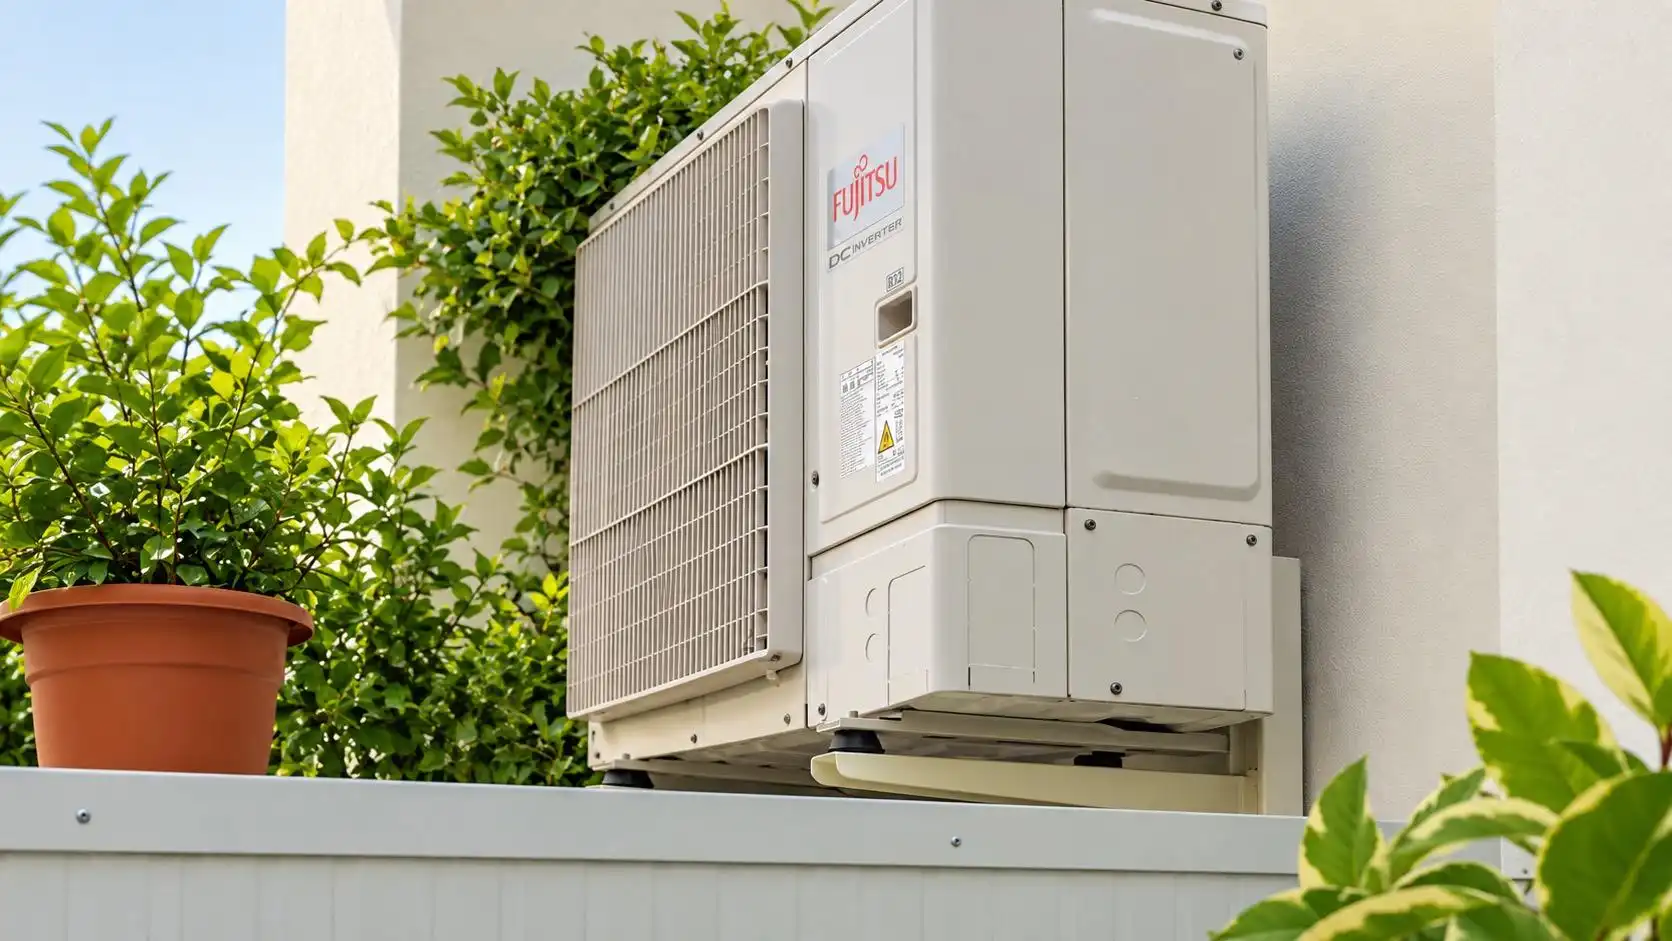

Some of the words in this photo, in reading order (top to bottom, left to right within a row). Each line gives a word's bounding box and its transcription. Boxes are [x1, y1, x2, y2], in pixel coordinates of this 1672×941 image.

[833, 154, 897, 222] FUJITSU
[829, 245, 851, 269] DC
[852, 217, 902, 254] INVERTER
